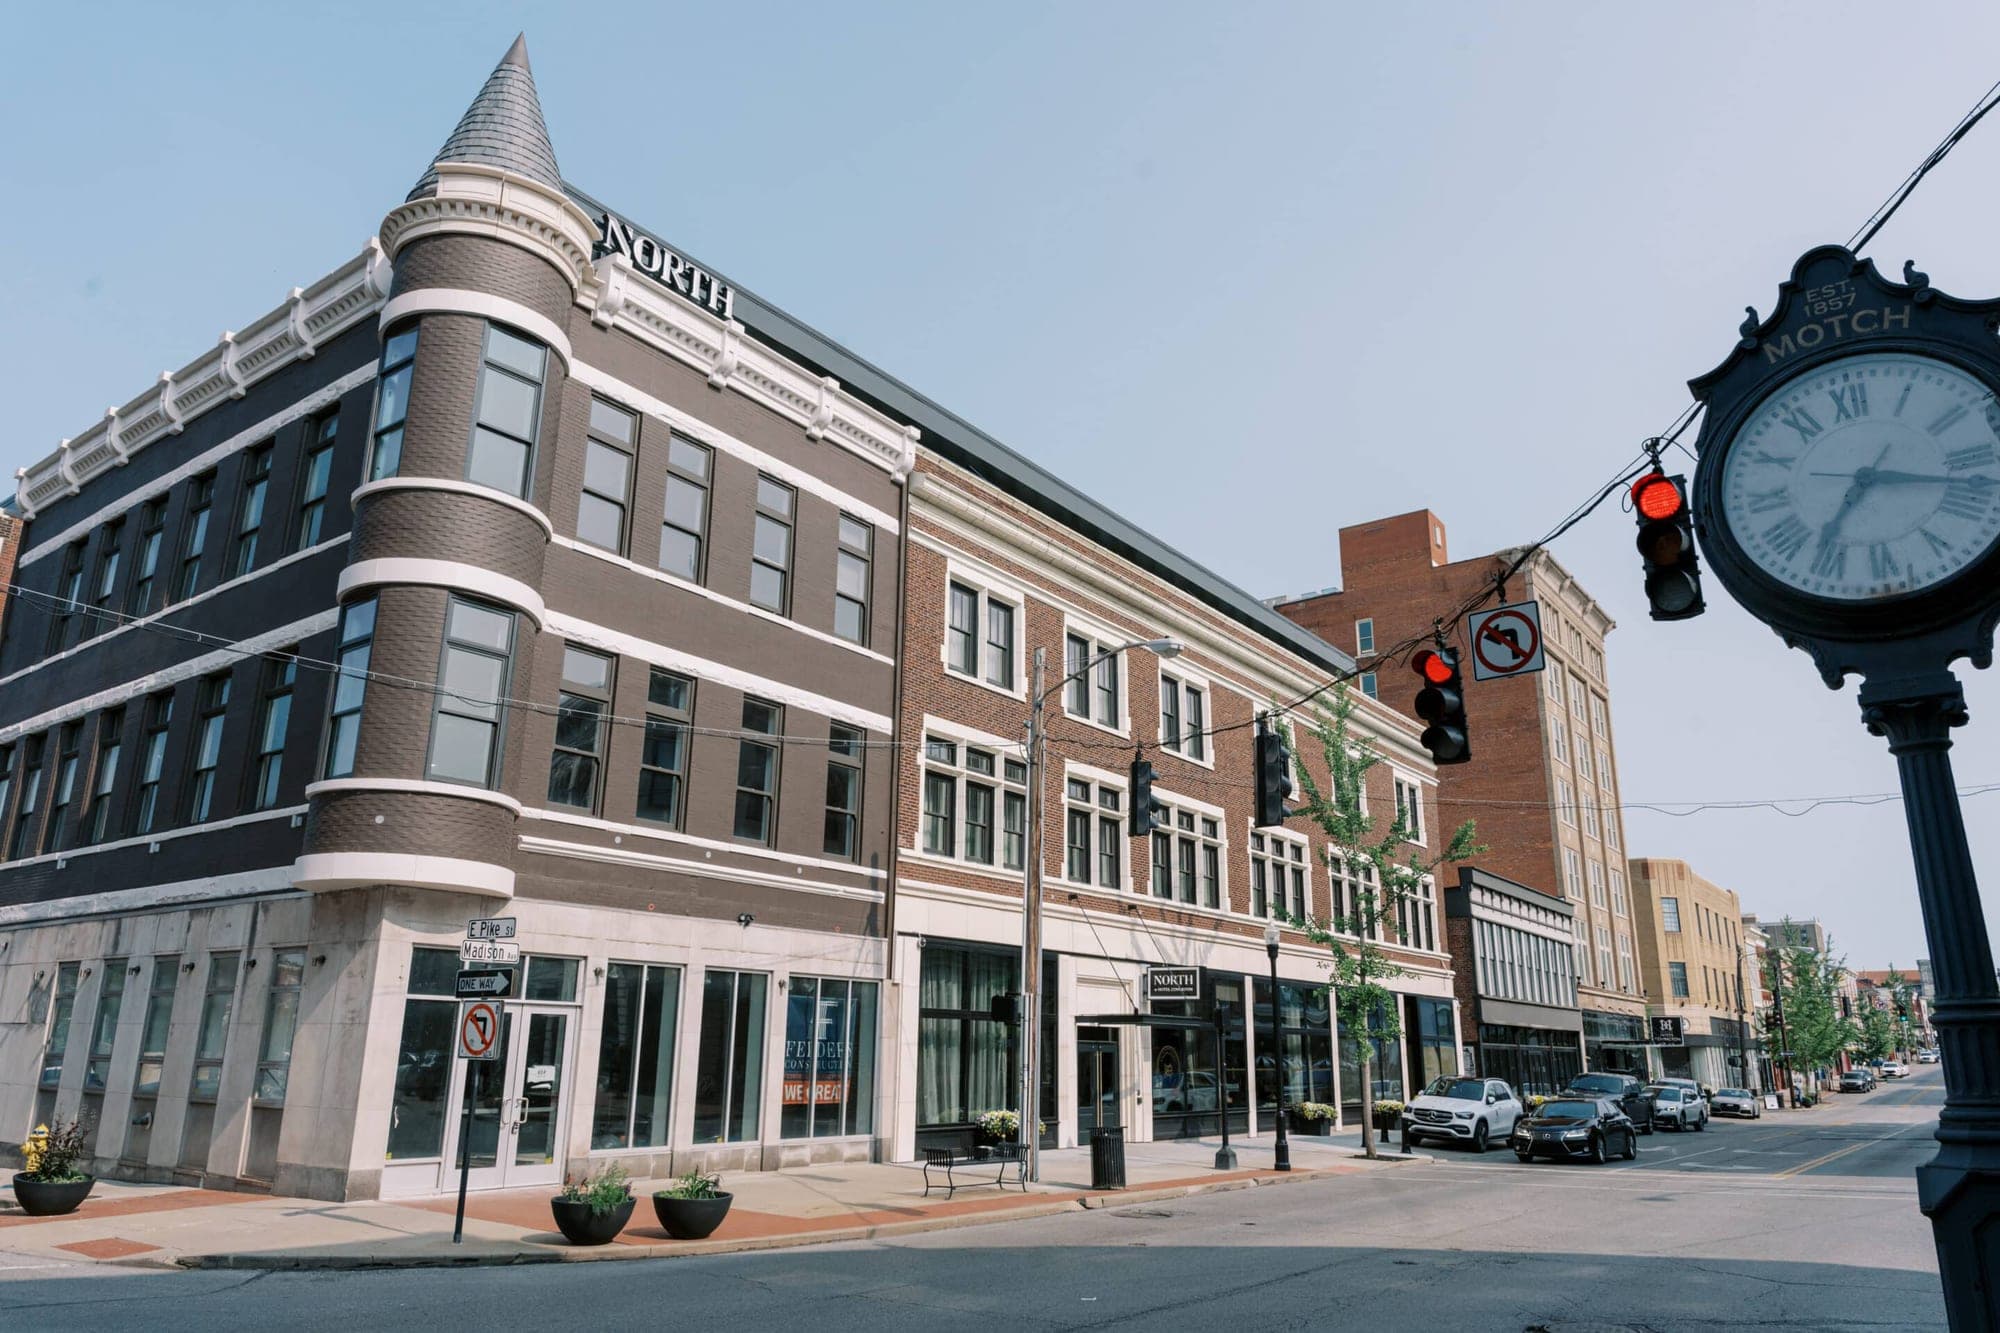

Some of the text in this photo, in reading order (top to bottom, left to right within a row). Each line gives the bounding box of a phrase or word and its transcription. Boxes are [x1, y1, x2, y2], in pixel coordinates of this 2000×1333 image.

[603, 213, 735, 320] NORTH
[1806, 279, 1855, 302] EST.
[1804, 292, 1857, 318] 1857
[1762, 305, 1910, 364] MOTCH
[470, 921, 513, 936] E Pike St
[464, 942, 504, 960] Madison
[460, 979, 496, 990] ONE WAY
[1154, 974, 1193, 985] NORTH
[784, 1084, 803, 1100] WE
